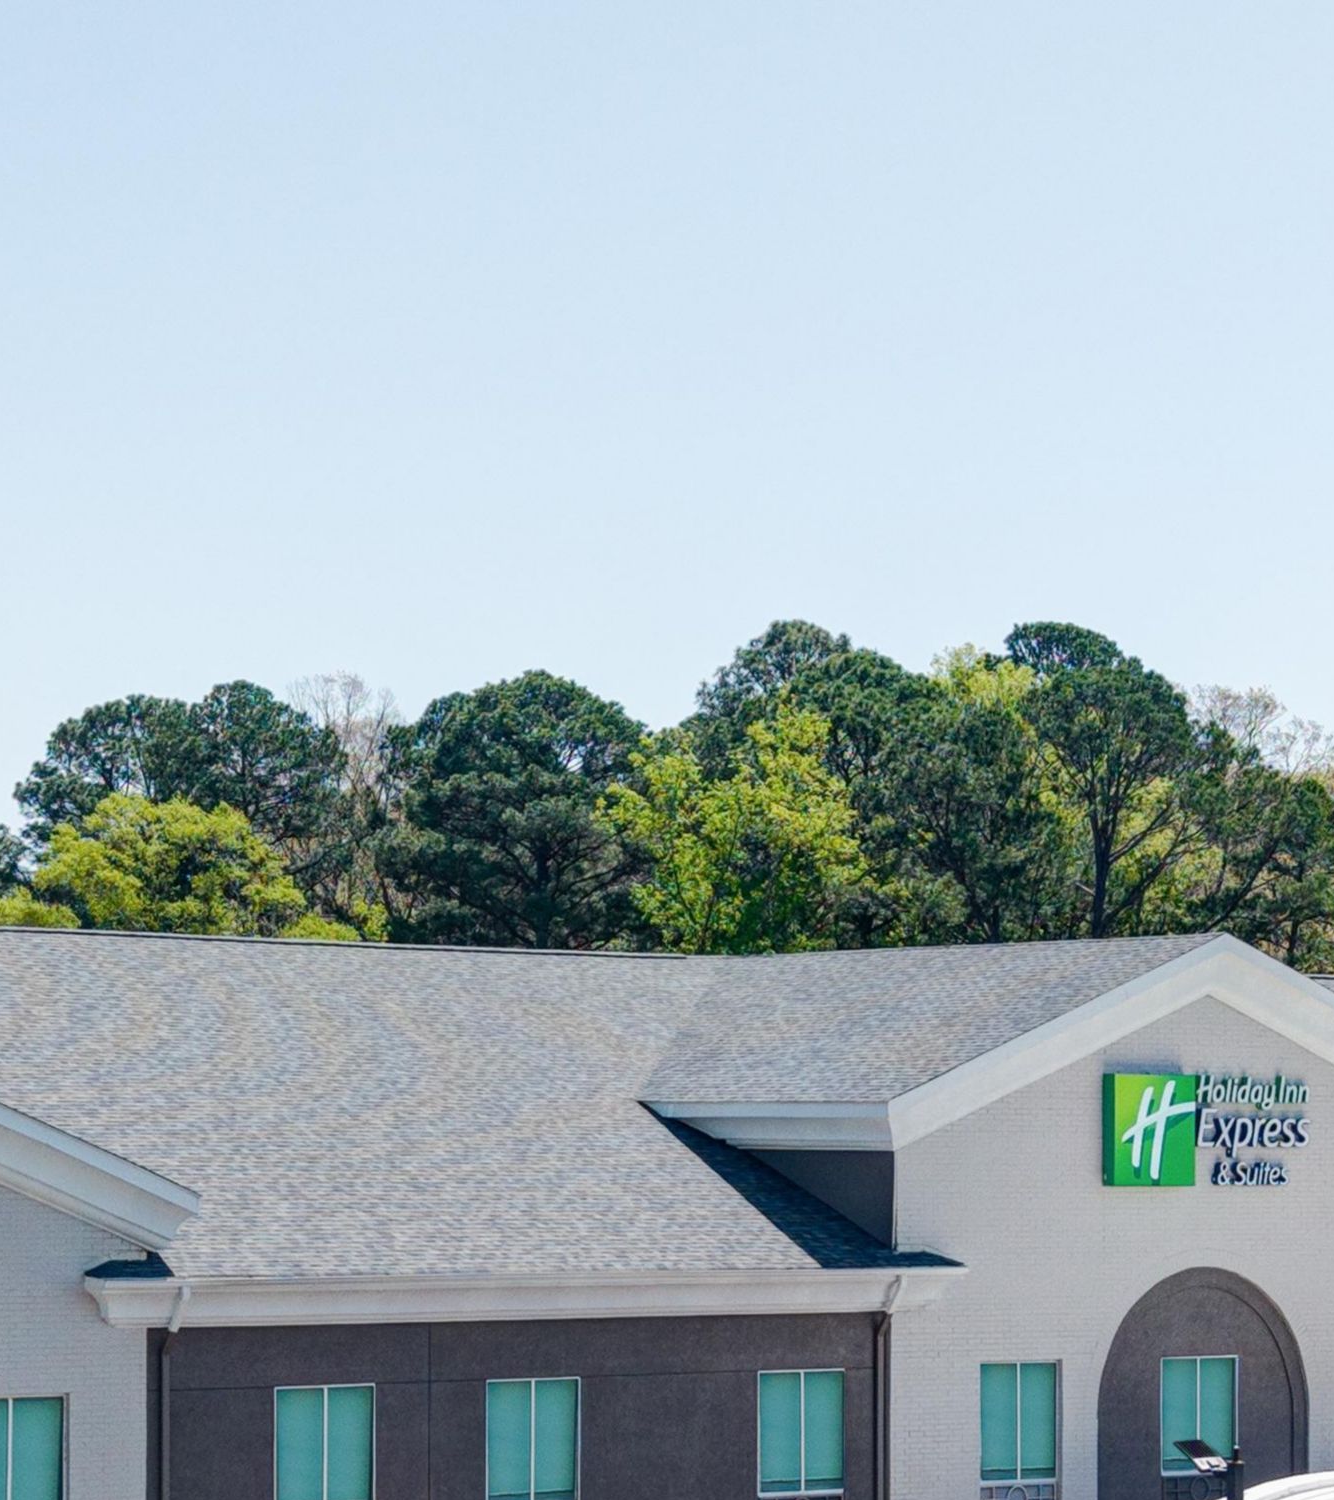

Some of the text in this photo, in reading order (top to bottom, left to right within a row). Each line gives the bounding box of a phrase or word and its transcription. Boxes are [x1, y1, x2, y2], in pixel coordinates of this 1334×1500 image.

[1196, 1075, 1310, 1110] Holiday Inn
[1197, 1108, 1311, 1158] Express
[1217, 1162, 1288, 1186] & Suites
